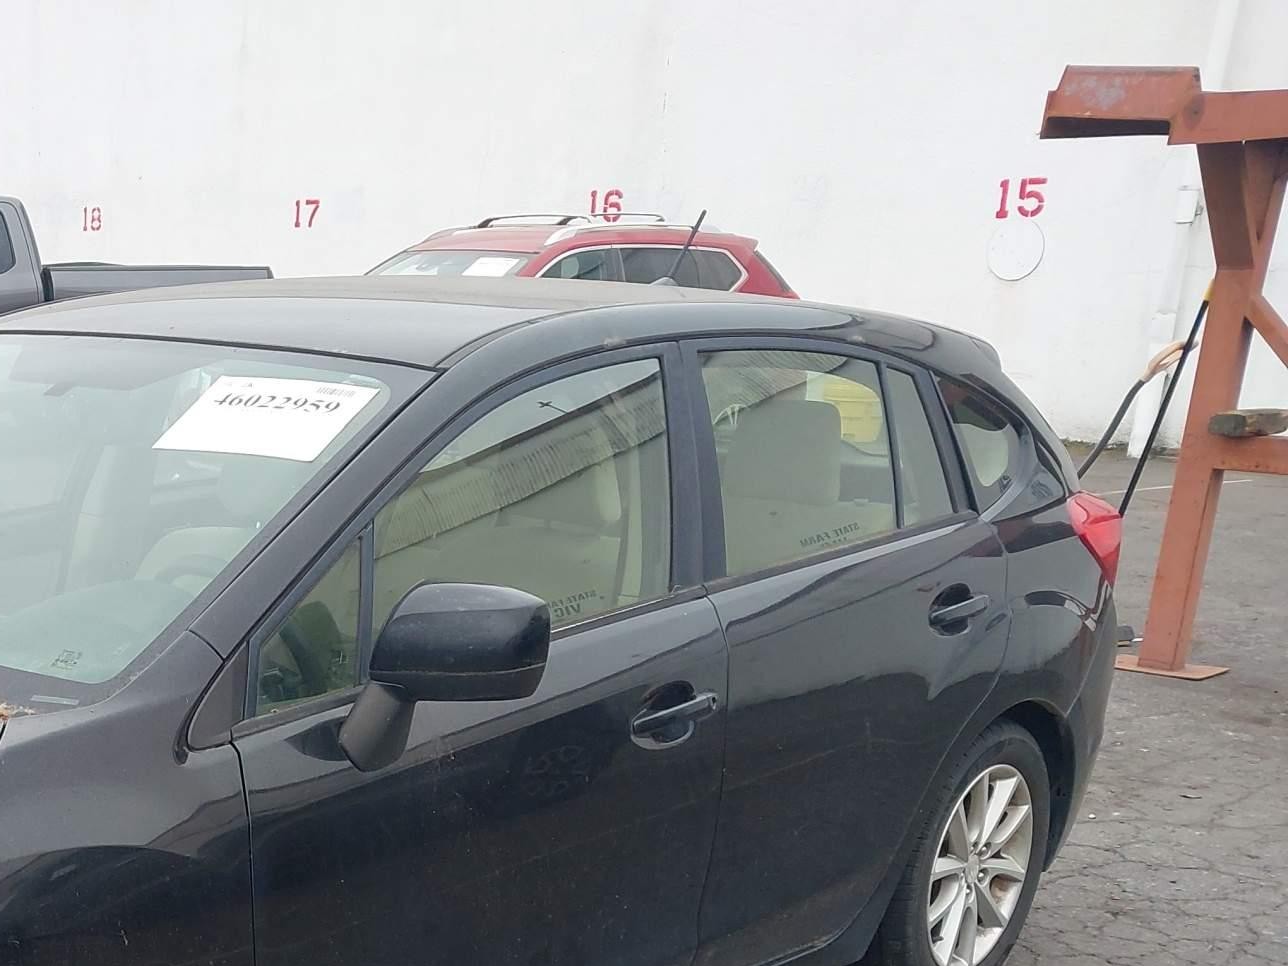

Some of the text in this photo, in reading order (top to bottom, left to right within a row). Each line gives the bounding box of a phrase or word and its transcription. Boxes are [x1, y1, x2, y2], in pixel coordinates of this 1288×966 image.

[590, 189, 624, 223] 16
[995, 177, 1048, 219] 15
[82, 206, 102, 231] 18
[294, 199, 321, 228] 17
[214, 392, 341, 414] 46022959
